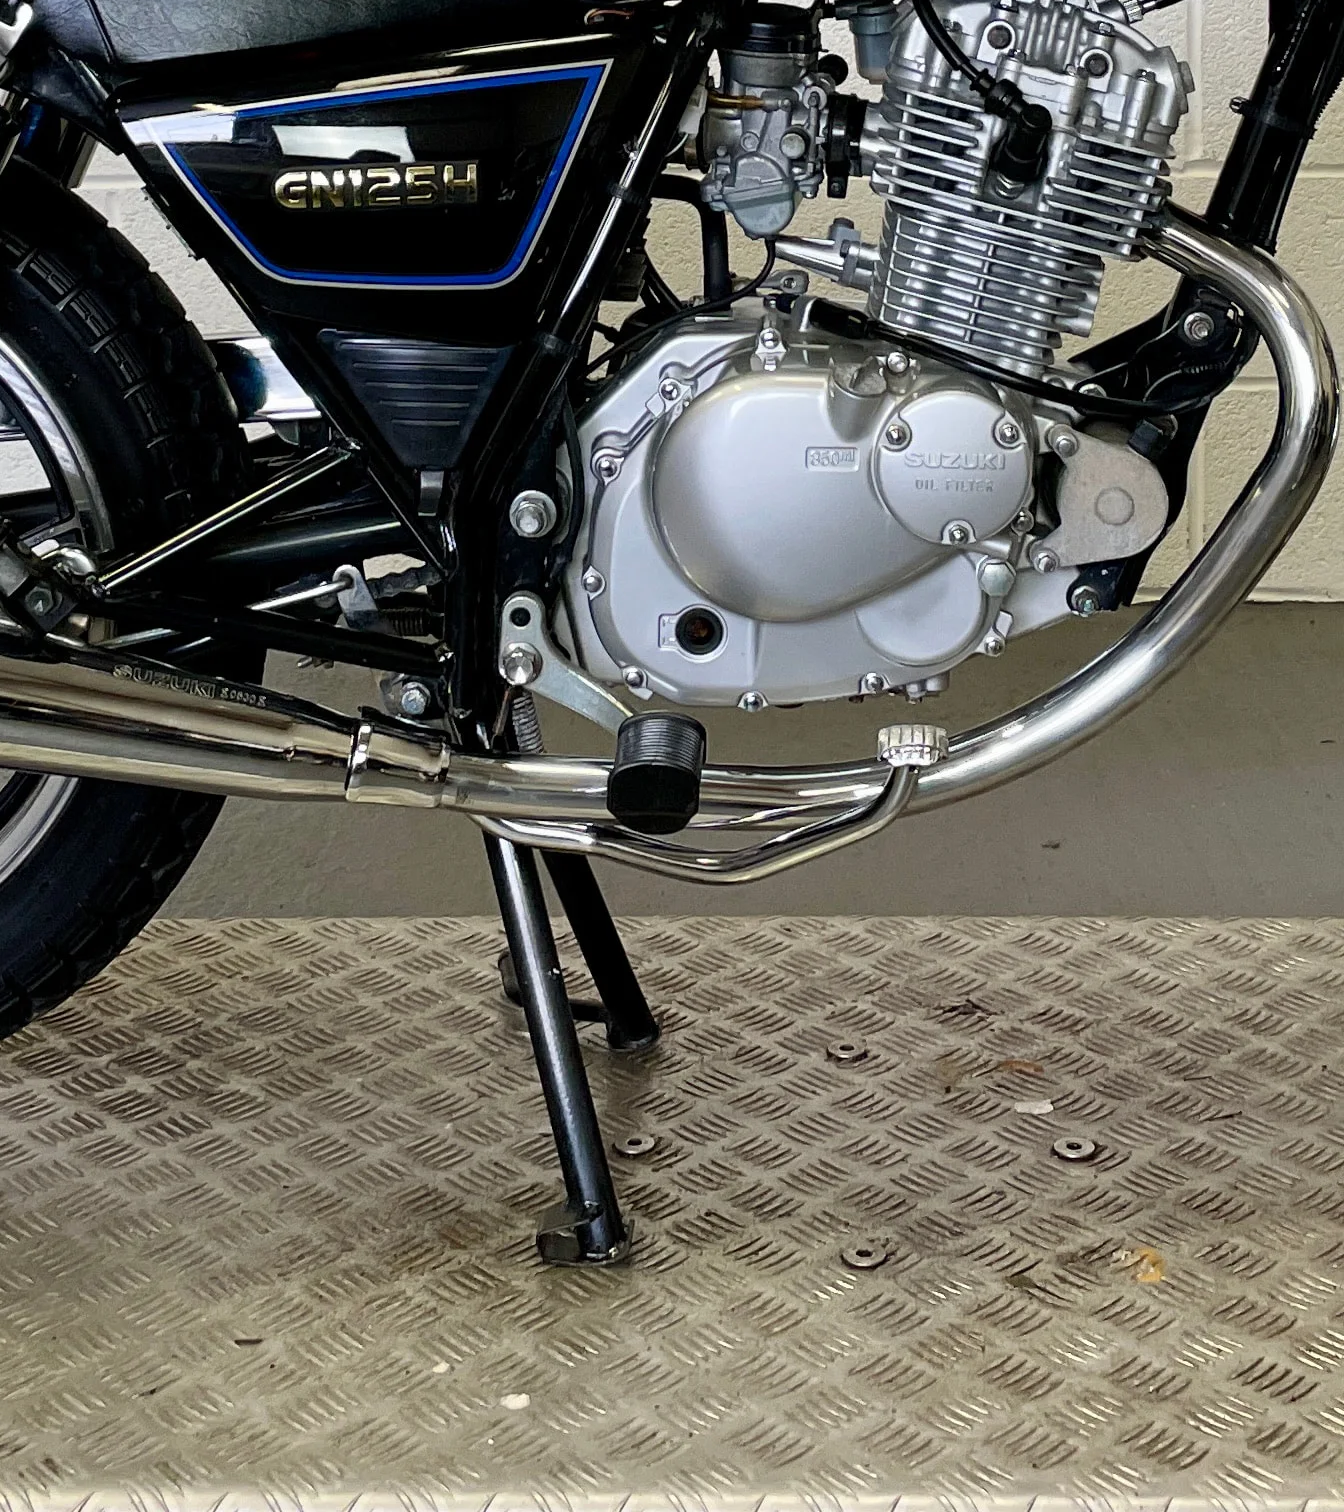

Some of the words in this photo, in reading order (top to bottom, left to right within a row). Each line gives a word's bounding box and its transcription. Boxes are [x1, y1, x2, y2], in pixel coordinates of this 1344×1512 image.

[274, 163, 478, 209] GN125H
[904, 452, 1006, 471] SUZUKI
[914, 478, 938, 491] OIL
[946, 478, 994, 493] FILTER
[112, 663, 216, 700] SUZUKI
